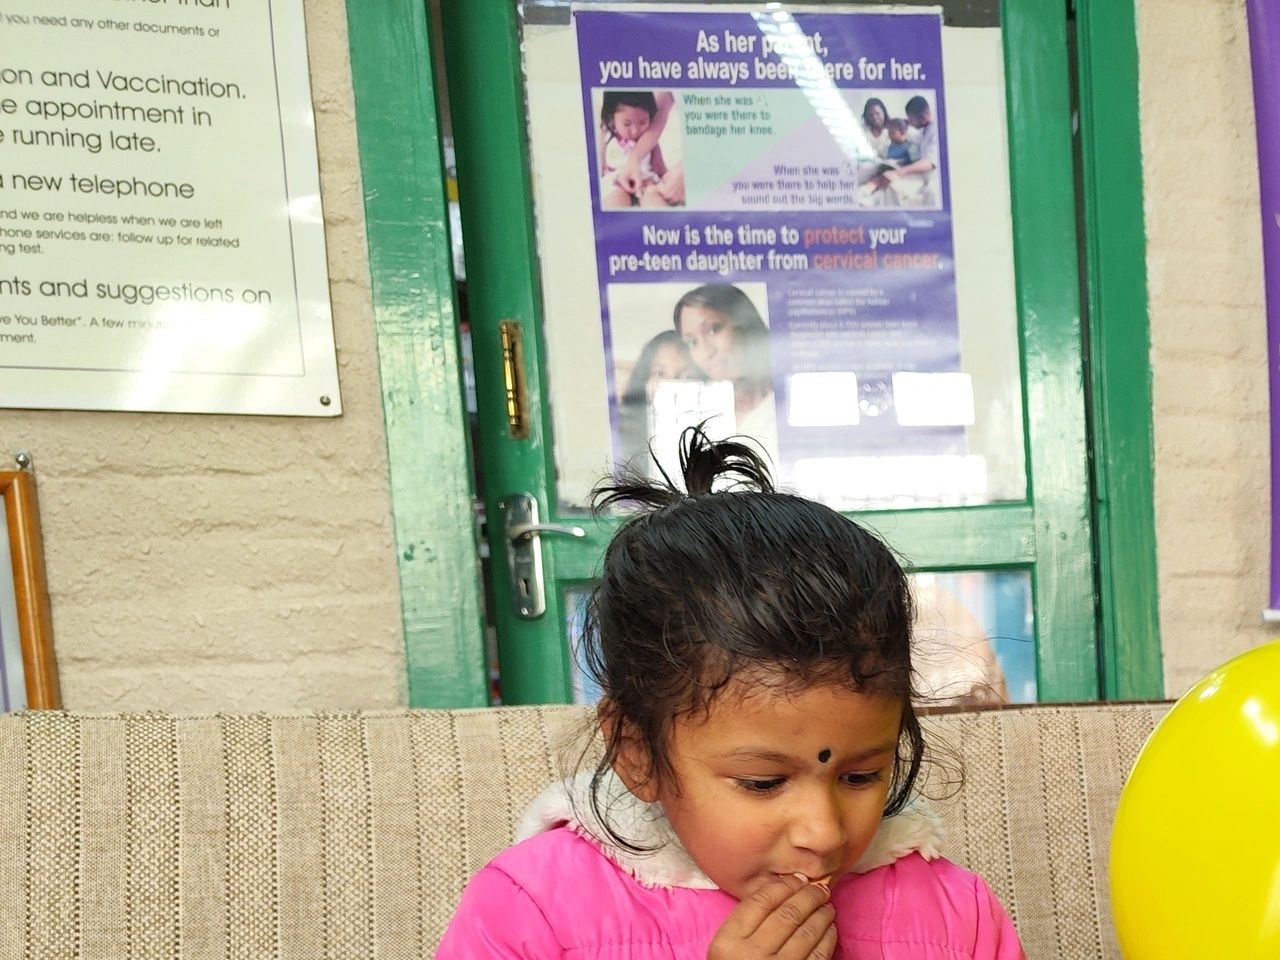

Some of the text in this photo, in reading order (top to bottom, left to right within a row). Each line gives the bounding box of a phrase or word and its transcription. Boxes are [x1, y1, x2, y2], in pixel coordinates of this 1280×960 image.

[5, 14, 220, 37] you need any other documents or
[696, 29, 720, 53] As
[724, 29, 756, 53] her
[599, 60, 634, 85] you
[638, 56, 682, 80] have
[687, 56, 750, 85] always
[858, 56, 886, 81] for
[890, 57, 926, 82] her.
[41, 69, 91, 89] and
[96, 70, 247, 99] Vaccination.
[26, 99, 185, 124] appointment
[192, 106, 212, 126] in
[683, 95, 753, 106] When she was
[685, 110, 771, 123] you were there to
[12, 128, 161, 153] running late.
[686, 125, 727, 138] bandage
[730, 125, 746, 136] her
[12, 173, 195, 199] new telephone
[21, 211, 40, 221] we
[43, 212, 65, 222] are
[68, 212, 118, 225] helpless
[121, 214, 156, 226] when
[158, 217, 177, 227] we
[180, 218, 201, 228] are
[204, 218, 223, 230] left
[19, 243, 44, 255] test.
[36, 228, 86, 241] services
[118, 231, 153, 244] follow
[157, 234, 174, 246] up
[177, 234, 194, 246] for
[196, 236, 240, 249] related
[642, 224, 907, 250] Now is the time to protect your
[608, 249, 944, 276] pre-teen daughter from cervical cancer.
[39, 279, 88, 298] and
[96, 282, 234, 305] suggestions
[242, 289, 272, 304] on
[14, 314, 38, 326] You
[89, 317, 100, 327] A
[102, 318, 124, 328] few
